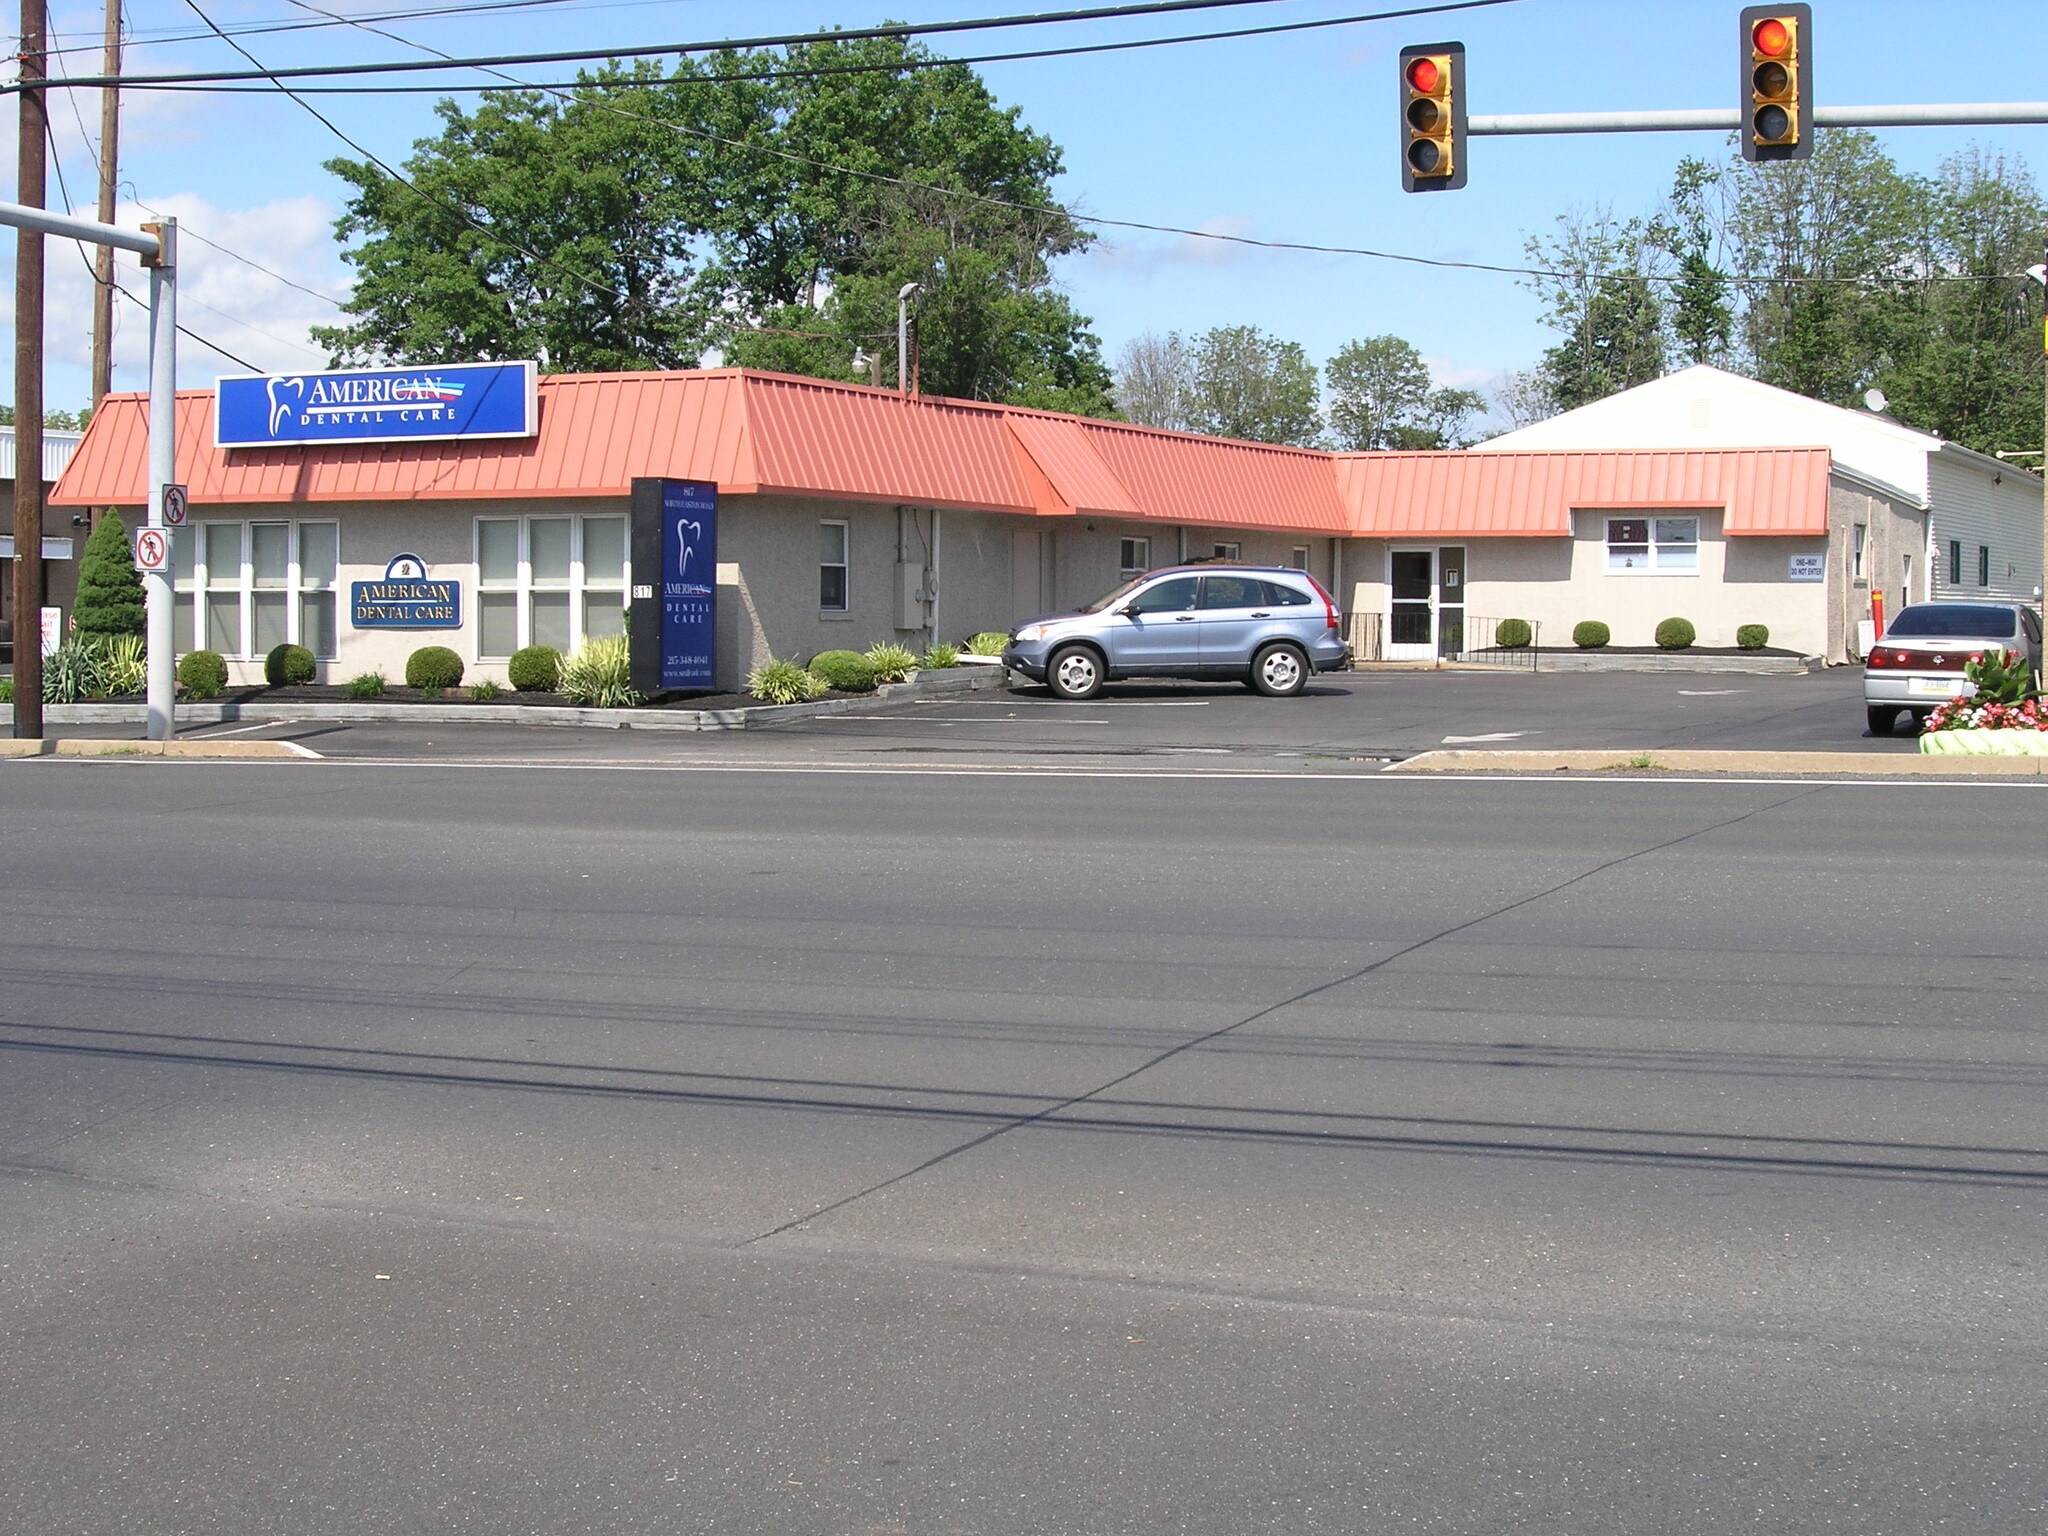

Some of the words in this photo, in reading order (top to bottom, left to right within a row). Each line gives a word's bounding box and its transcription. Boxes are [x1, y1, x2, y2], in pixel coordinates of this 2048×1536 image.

[308, 376, 443, 404] AMERICAN
[301, 412, 383, 425] DENTAL
[401, 408, 456, 420] CARE
[358, 585, 450, 603] AMERICAN
[634, 585, 651, 597] 817
[664, 583, 706, 595] AMERICAN
[357, 606, 412, 619] DENTAL
[415, 606, 453, 619] CARE
[666, 603, 710, 612] DENTAL
[674, 615, 702, 623] CARE
